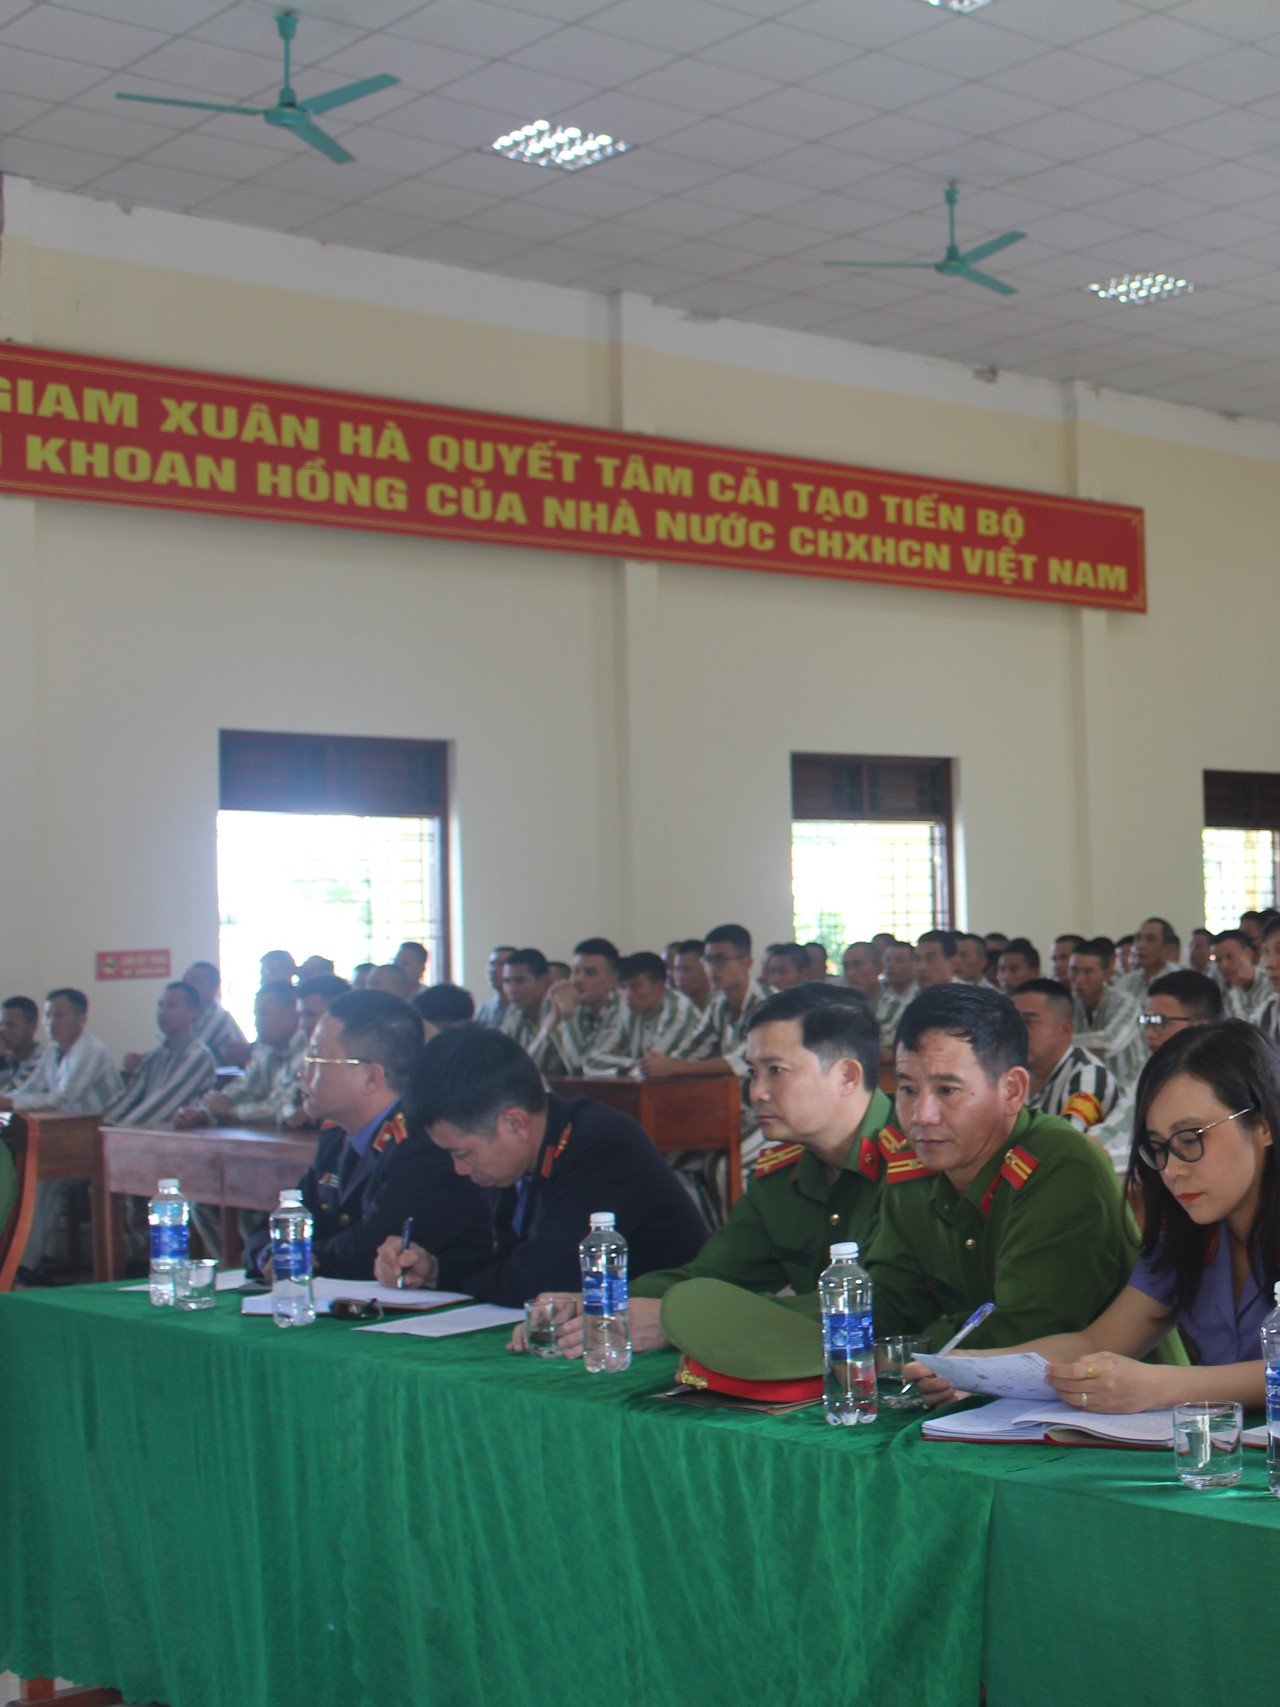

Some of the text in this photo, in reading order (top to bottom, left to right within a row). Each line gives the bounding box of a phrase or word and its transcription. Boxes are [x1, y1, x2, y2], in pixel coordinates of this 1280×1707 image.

[27, 435, 235, 491] KHOAN
[258, 460, 407, 510] HỒNG
[427, 480, 526, 523] CỦA
[544, 497, 640, 536] NHÀ
[656, 510, 774, 551] NƯỚC
[790, 526, 950, 571] CHXHCN
[963, 547, 1036, 583] VIỆT
[1049, 558, 1127, 591] NAM
[163, 399, 319, 450] XUÂN
[340, 423, 410, 461] HÀ
[429, 435, 580, 482] QUYẾT
[597, 456, 692, 496] TÂM
[709, 469, 778, 507] CẢI
[793, 483, 868, 520] TẠO
[882, 496, 964, 531] TIẾN
[977, 509, 1024, 543] BỘ
